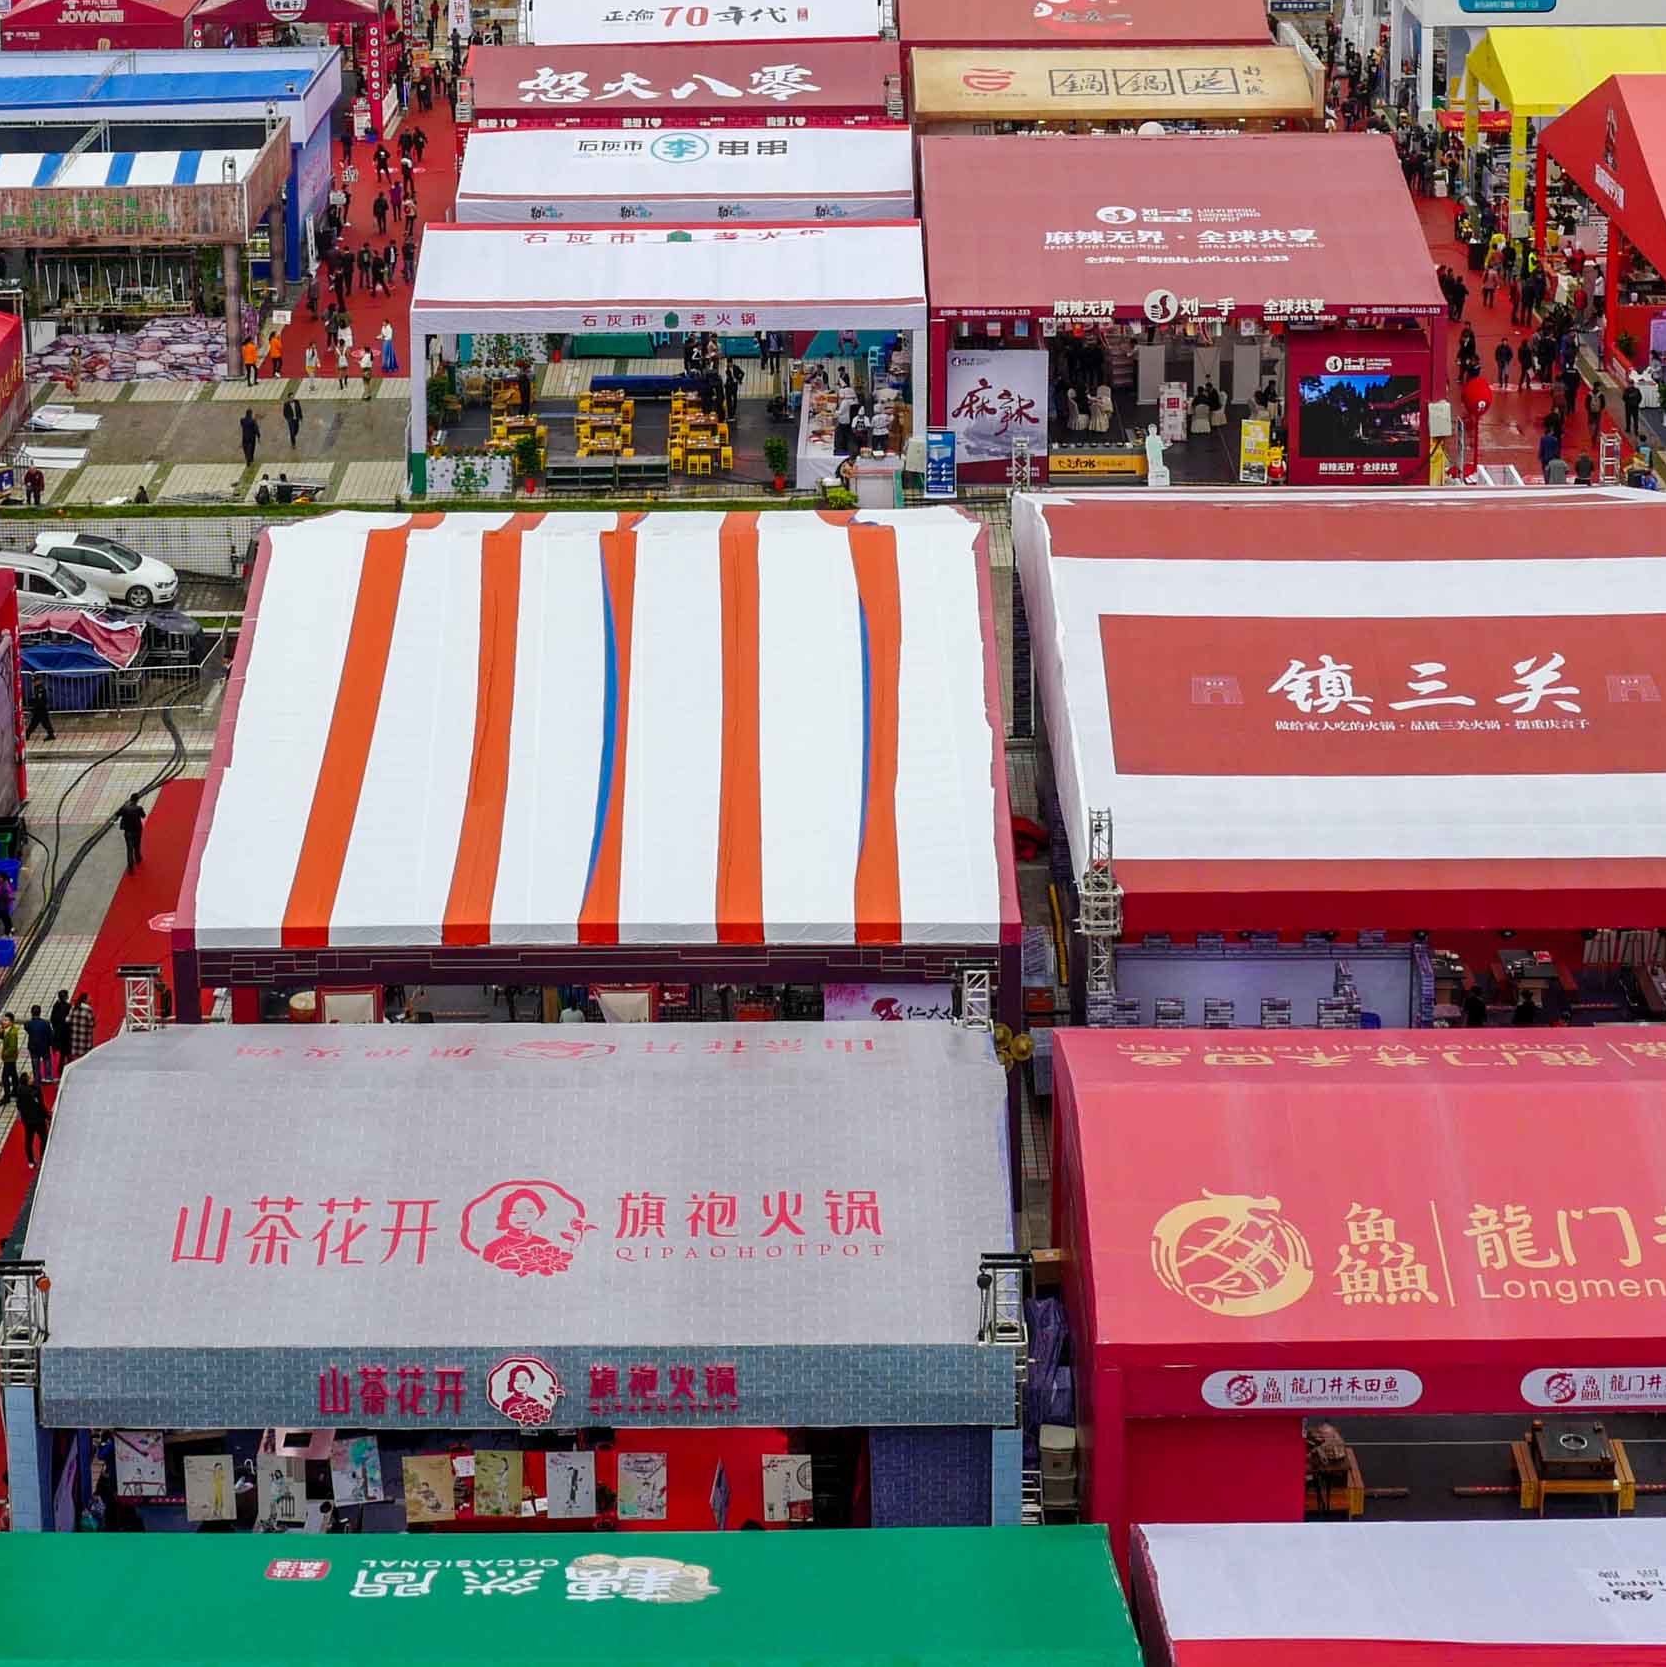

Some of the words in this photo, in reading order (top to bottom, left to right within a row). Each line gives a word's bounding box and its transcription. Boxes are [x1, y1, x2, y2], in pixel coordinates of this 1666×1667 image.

[517, 63, 822, 103] 怒火八零
[1044, 229, 1165, 245] 麻辣无界
[1196, 229, 1318, 245] 全球共享
[581, 313, 648, 327] 石灰市
[690, 312, 757, 326] 老火锅
[1053, 299, 1116, 317] 麻辣无界
[1180, 297, 1237, 317] 刘一手
[1264, 298, 1326, 315] 全球共享
[1267, 651, 1583, 714] 镇三关
[171, 1193, 440, 1268] 山茶花开
[615, 1188, 884, 1241] 旗袍火锅
[318, 1365, 466, 1417] 山茶花开
[587, 1364, 739, 1402] 旗袍火锅
